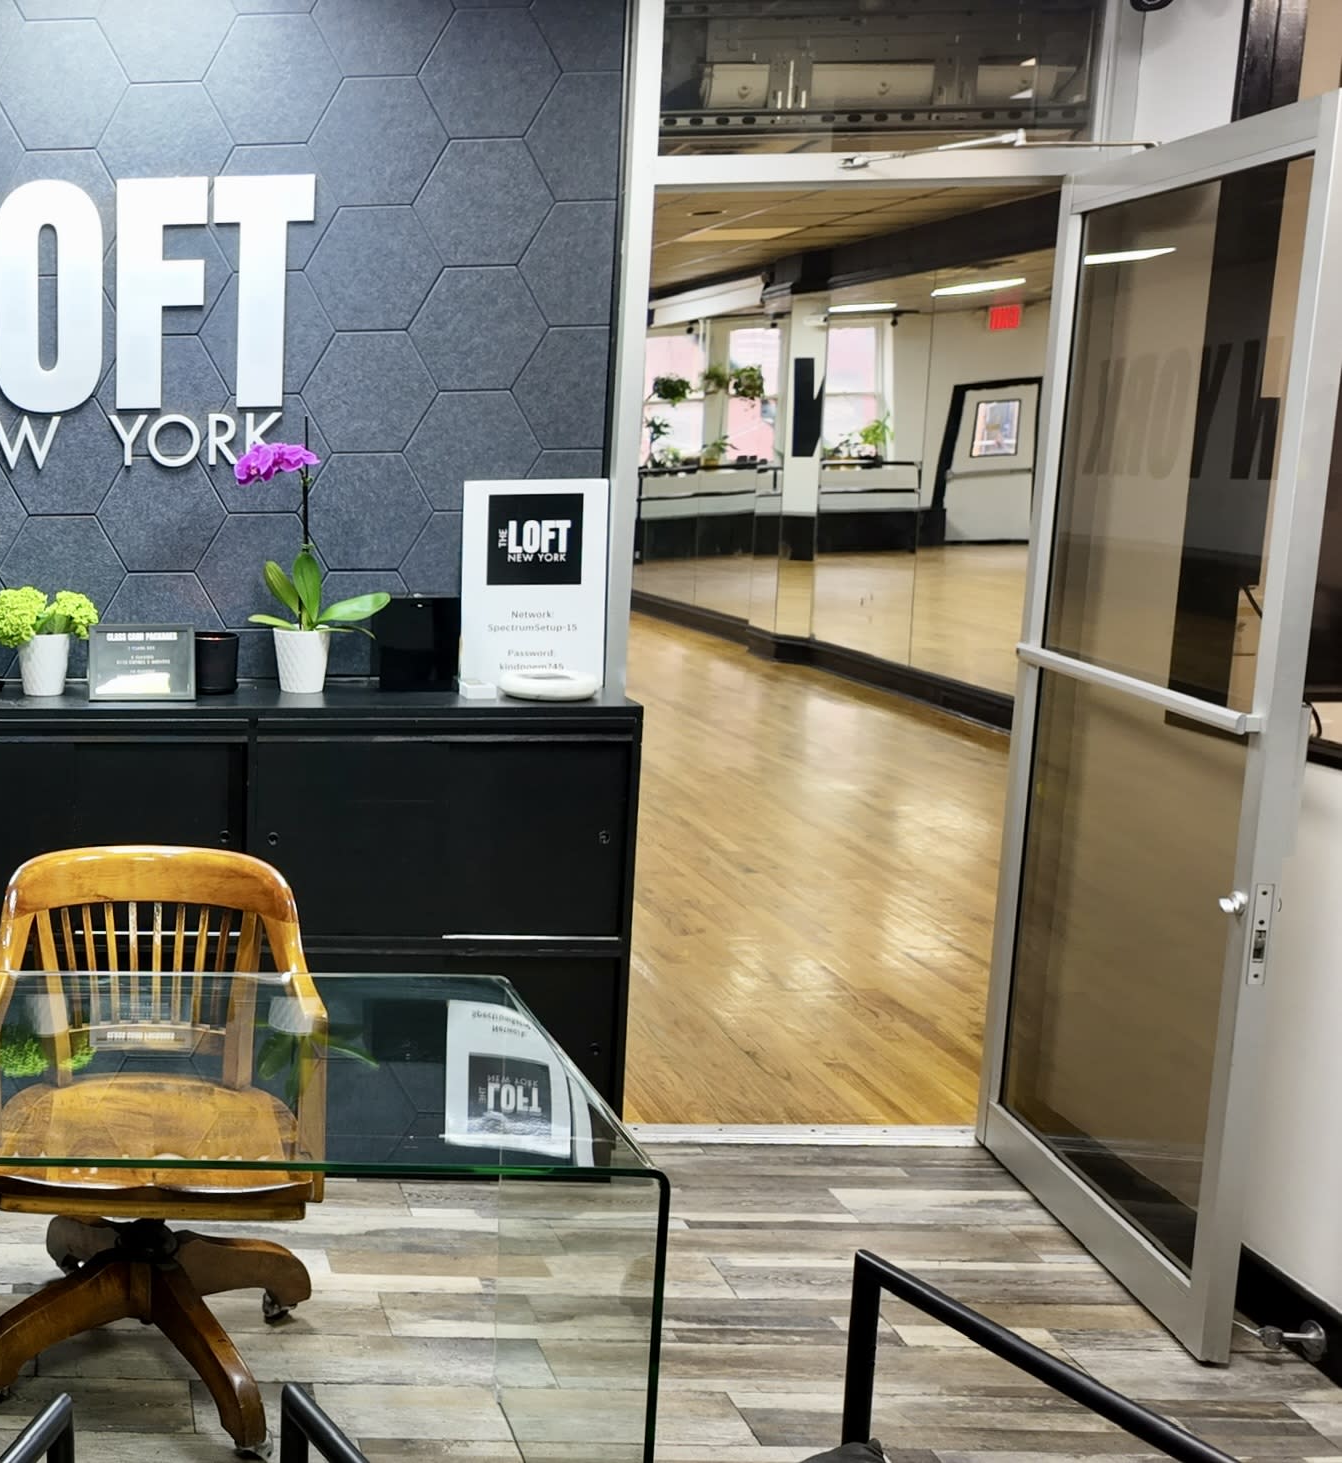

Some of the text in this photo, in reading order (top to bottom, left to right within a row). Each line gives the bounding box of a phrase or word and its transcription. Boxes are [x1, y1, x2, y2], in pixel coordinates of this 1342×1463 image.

[498, 528, 508, 548] THE
[508, 520, 572, 553] LOFT
[507, 552, 566, 562] NEW YORK
